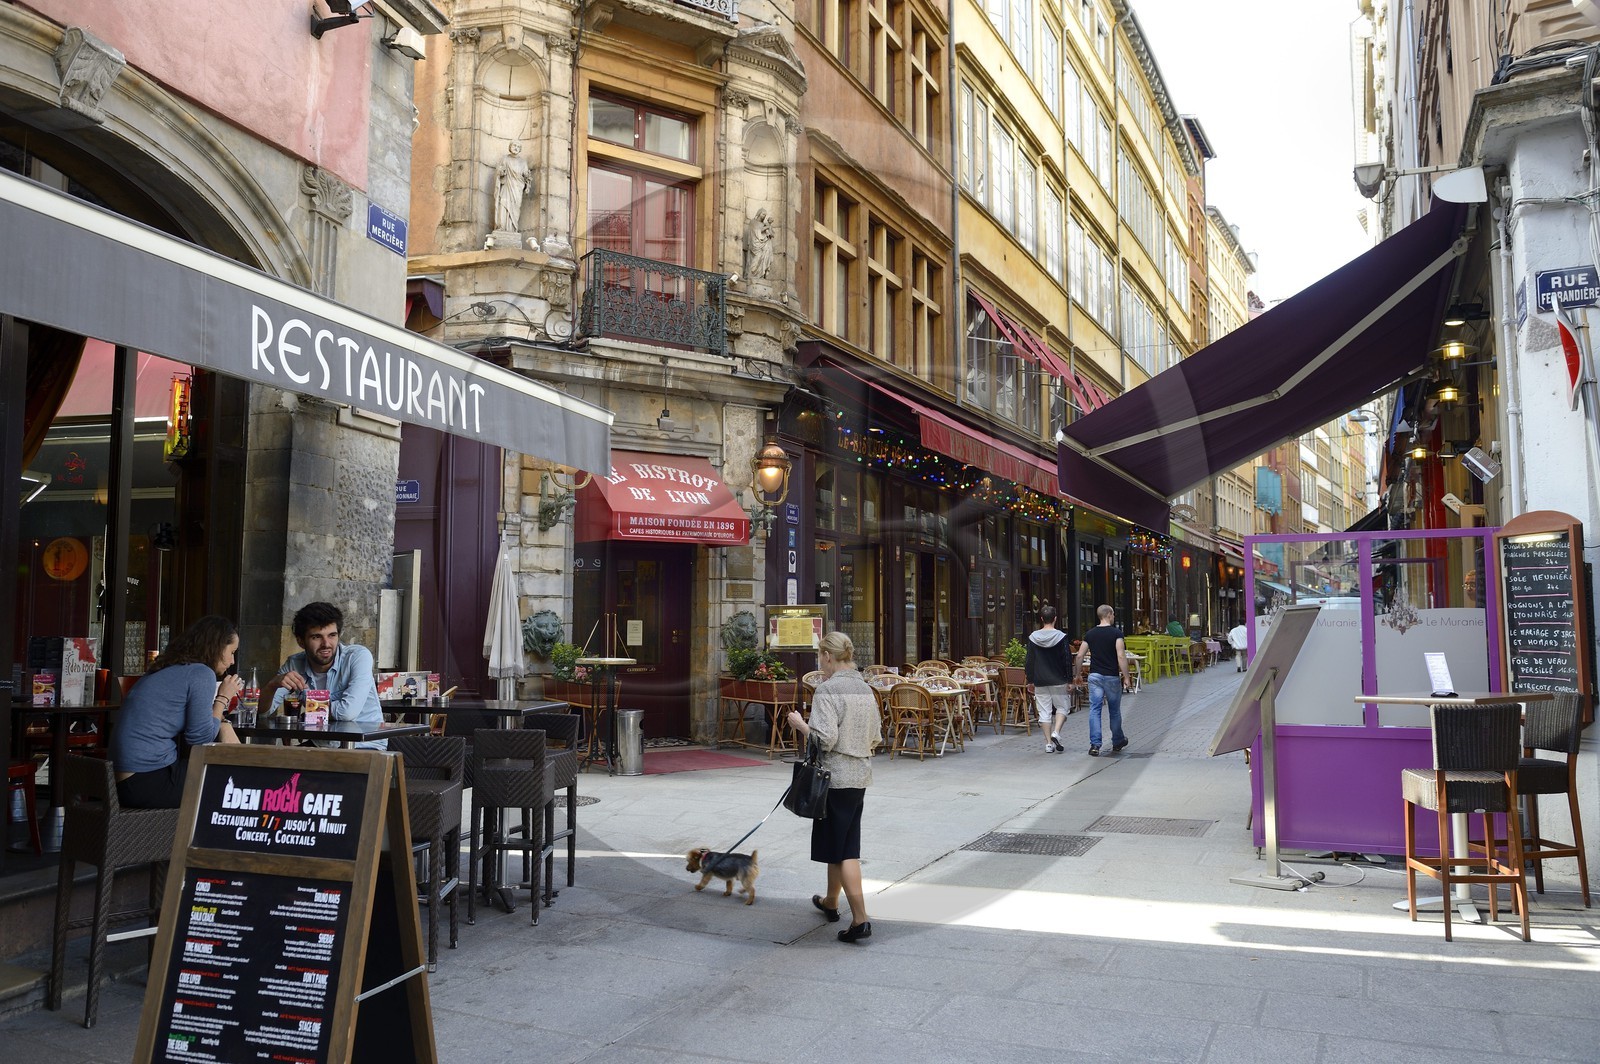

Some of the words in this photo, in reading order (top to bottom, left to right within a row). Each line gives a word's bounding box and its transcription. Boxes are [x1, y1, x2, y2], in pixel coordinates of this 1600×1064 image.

[382, 218, 396, 232] RUE
[372, 224, 404, 250] MERCIÈRE
[1550, 272, 1588, 288] RUE
[251, 304, 486, 433] RESTAURANT
[604, 466, 628, 485] LE
[629, 463, 718, 493] BISTROT
[628, 486, 656, 502] DE
[665, 489, 711, 505] LYON
[630, 516, 665, 527] MAISON
[668, 518, 702, 528] FONDÉE
[703, 520, 715, 530] EN
[716, 520, 735, 530] 1896
[1514, 610, 1558, 618] LYONNAISE
[1316, 618, 1357, 627] Muranie
[1426, 618, 1437, 627] Le
[1440, 617, 1484, 626] Muranie
[1520, 628, 1549, 637] MARIAGE
[1528, 639, 1558, 647] HOMARD
[1512, 656, 1528, 665] FOIE
[1520, 666, 1554, 674] PERSILLÉ
[262, 775, 302, 814] ROCK
[302, 792, 343, 817] CAFE
[261, 814, 282, 831] 7/7
